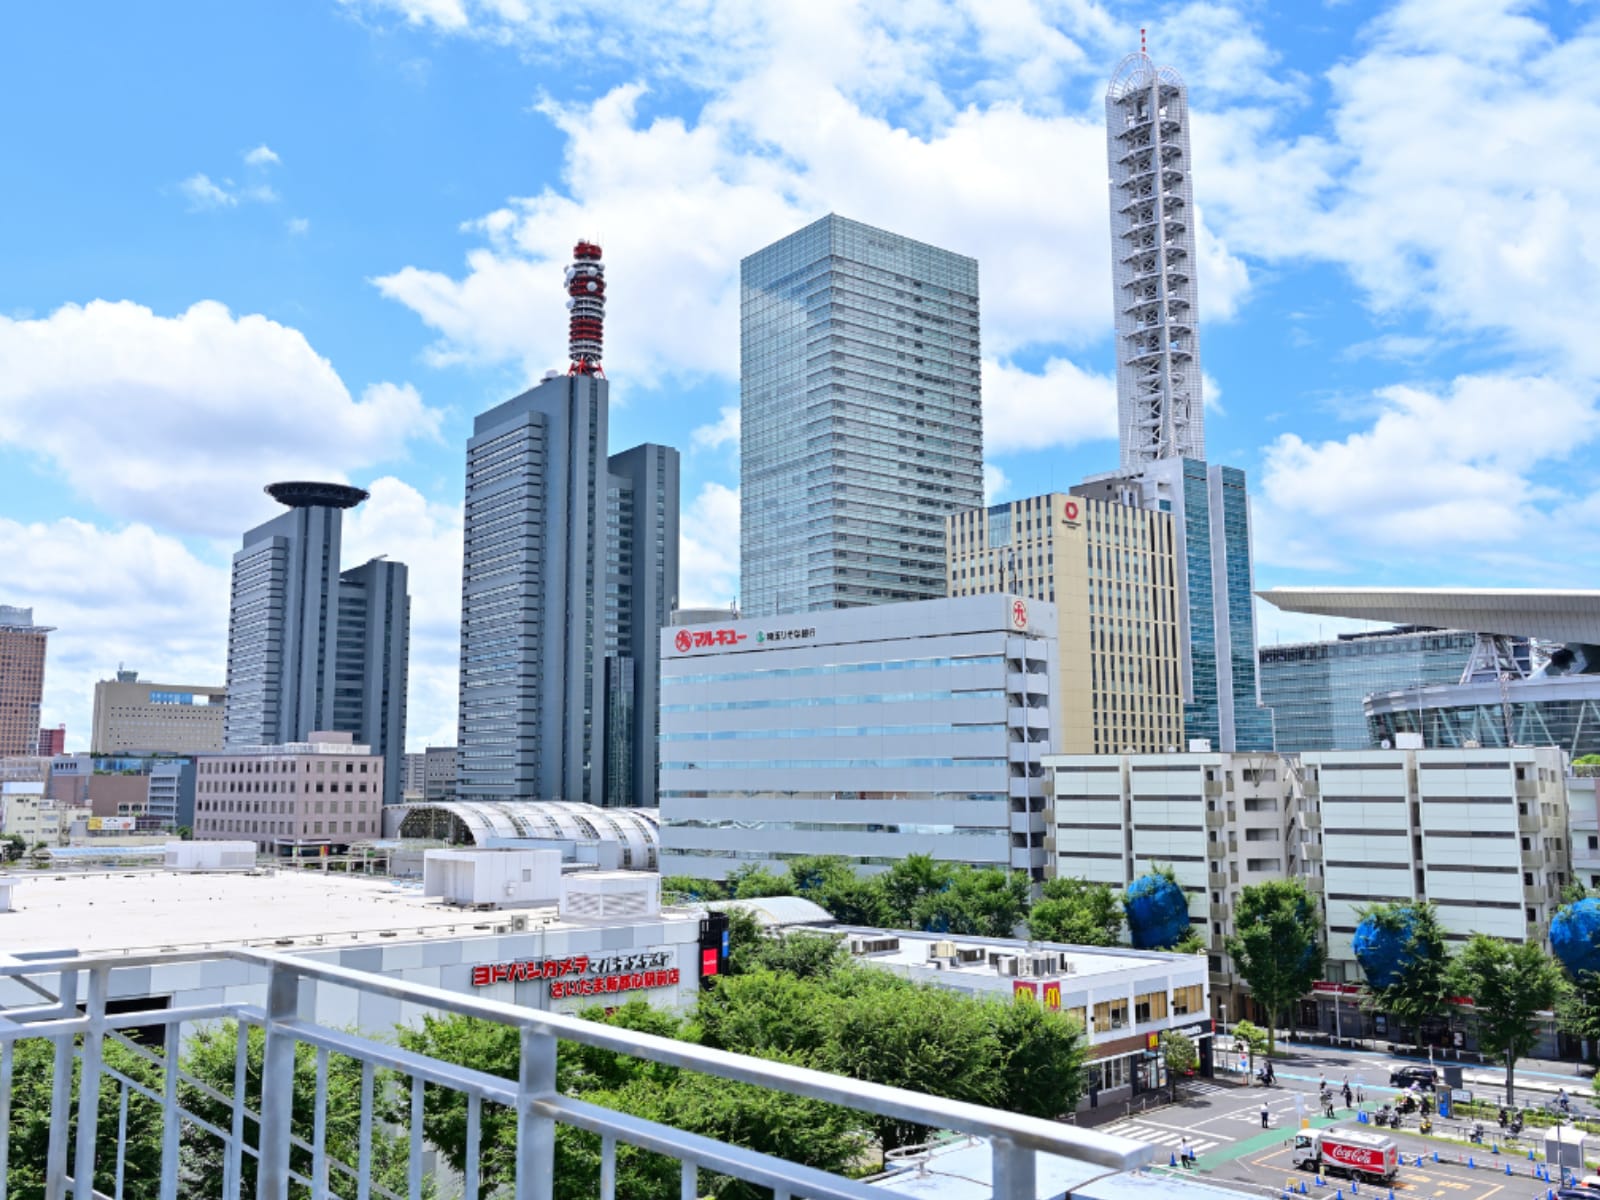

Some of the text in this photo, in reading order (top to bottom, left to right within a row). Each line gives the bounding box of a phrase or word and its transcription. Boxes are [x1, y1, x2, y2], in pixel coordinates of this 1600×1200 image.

[692, 629, 748, 648] マルキュー
[766, 627, 816, 641] 埼玉りそな銀行
[473, 951, 673, 987] ヨドバシカメラ マルチメディア
[550, 968, 681, 999] さいたま新都心駅前店
